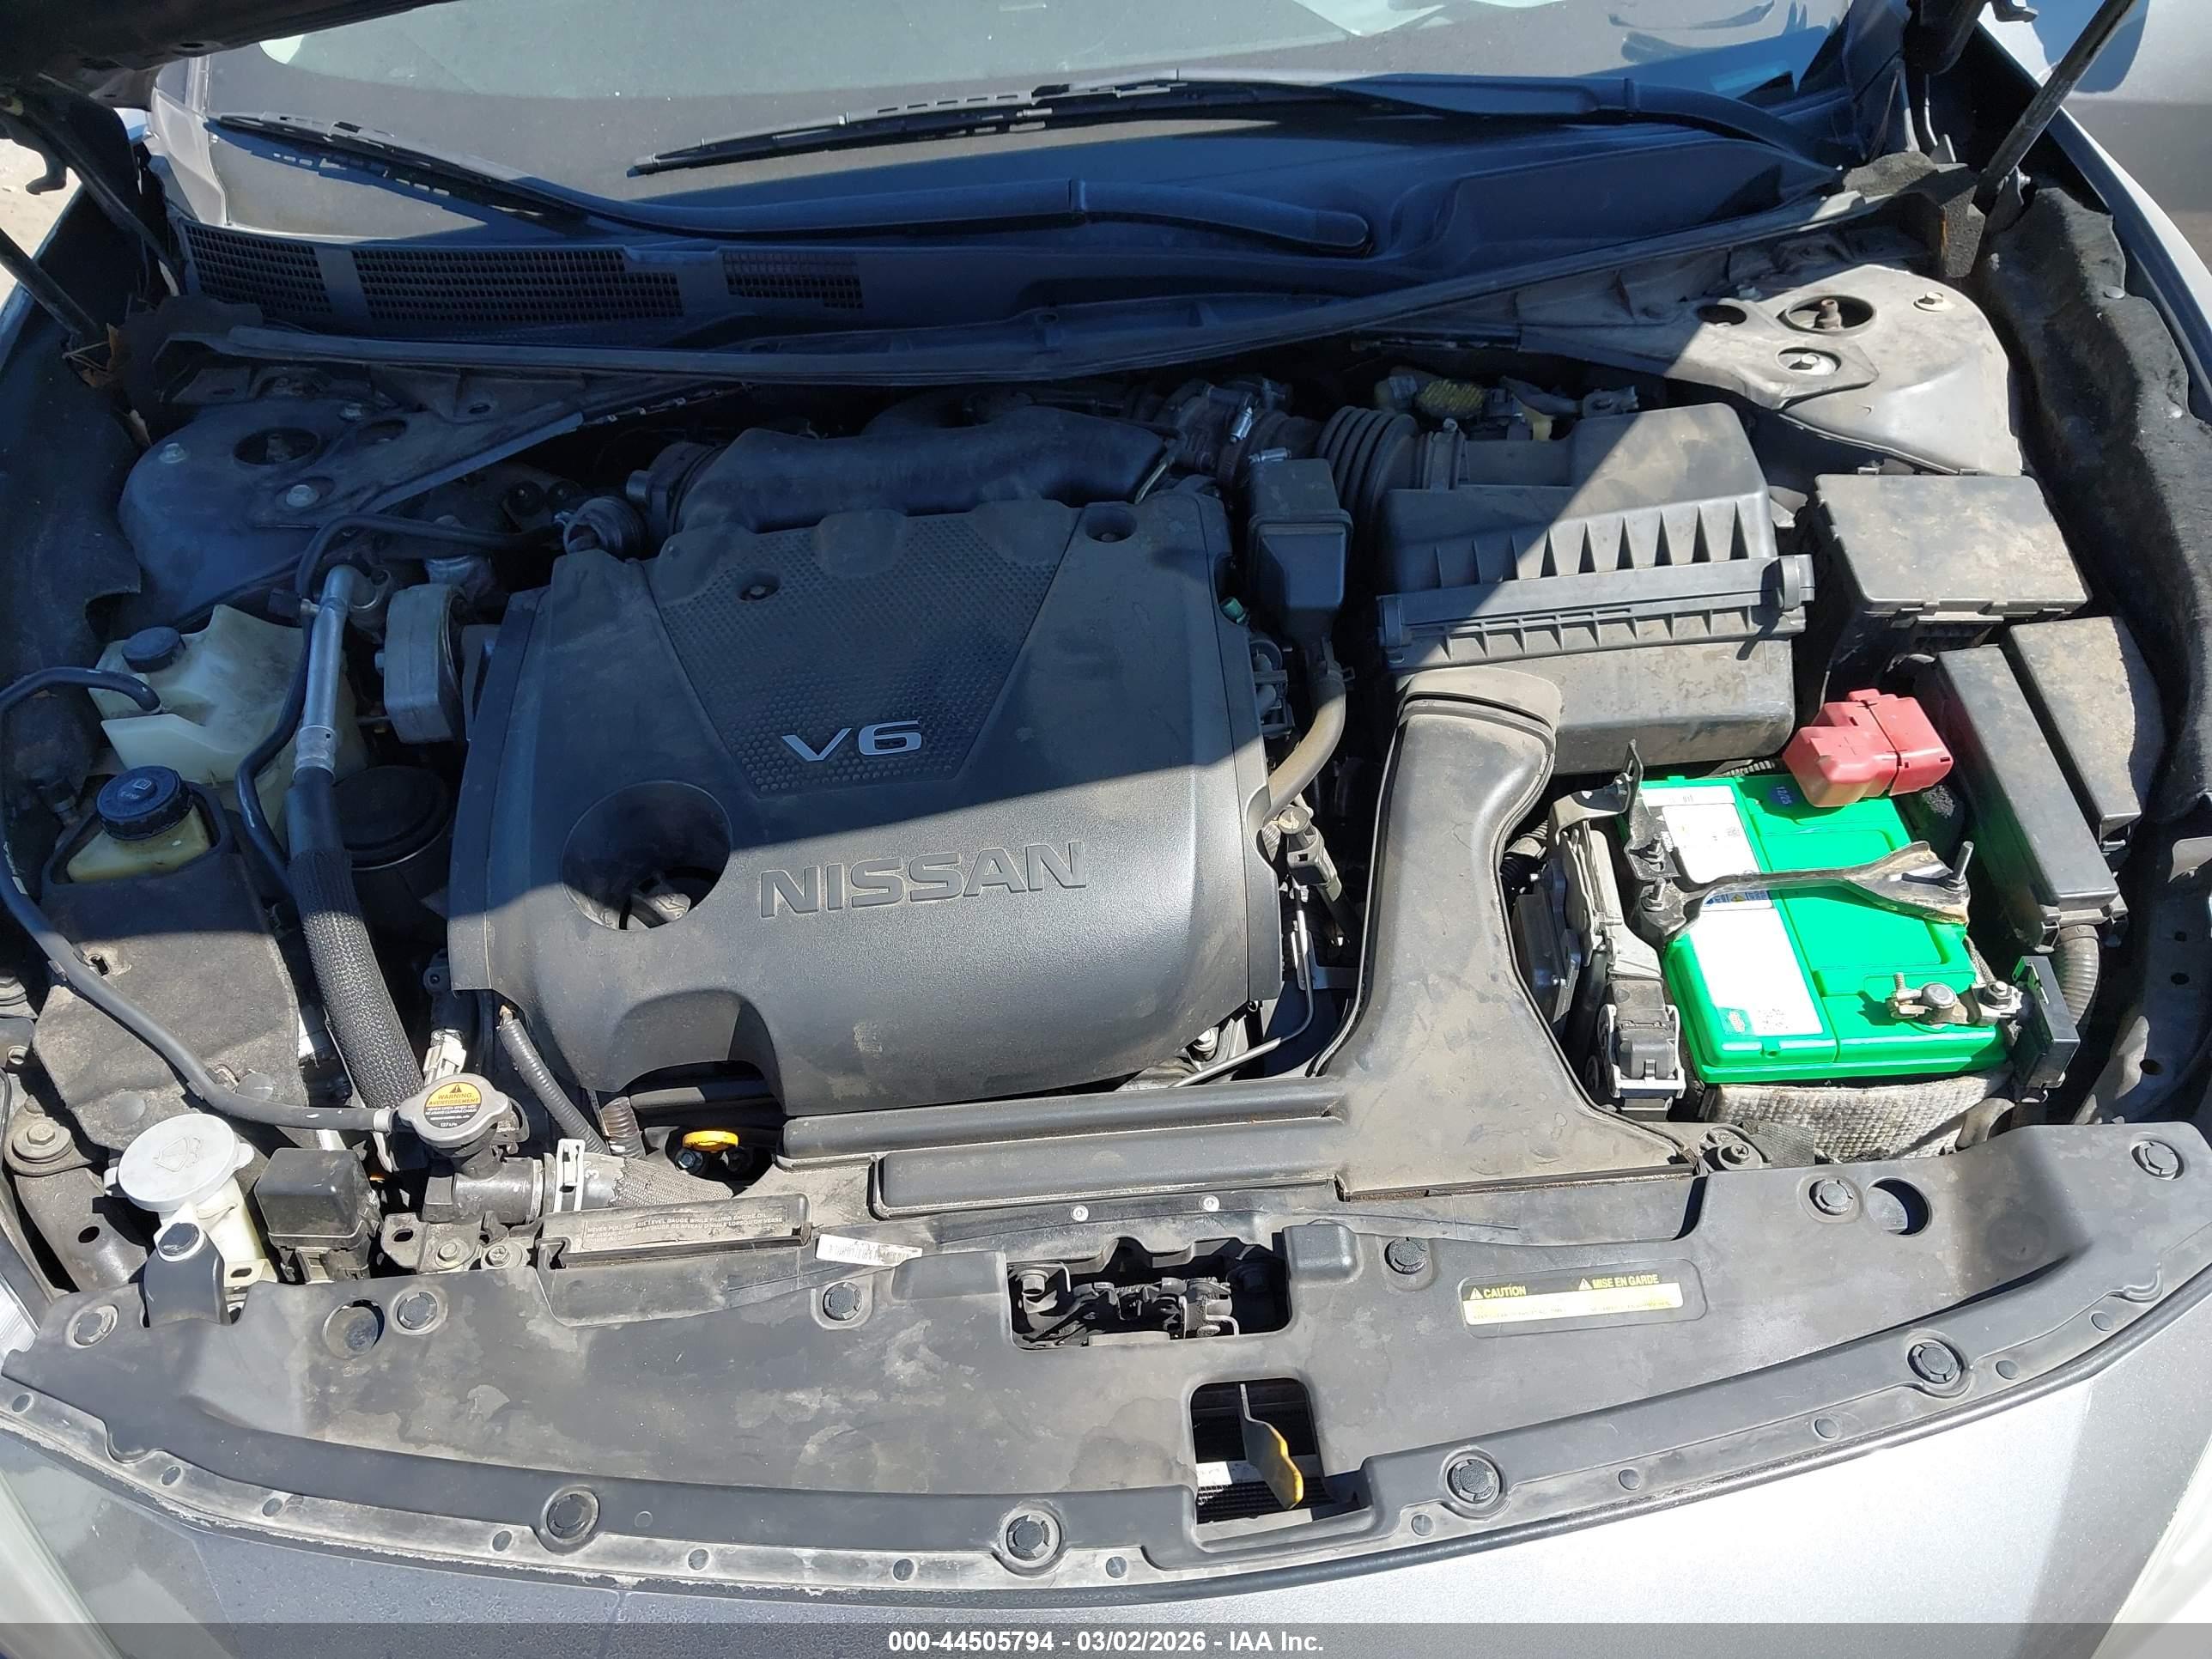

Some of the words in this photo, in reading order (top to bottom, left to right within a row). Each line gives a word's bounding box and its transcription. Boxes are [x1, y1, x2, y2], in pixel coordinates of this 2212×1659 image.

[781, 720, 923, 763] V6
[1775, 786, 1793, 805] 12/25
[760, 840, 1088, 919] NISSAN
[1592, 1277, 1614, 1289] MISE
[1614, 1276, 1628, 1287] EN
[1628, 1273, 1660, 1286] GARDE
[1483, 1285, 1527, 1298] CAUTION
